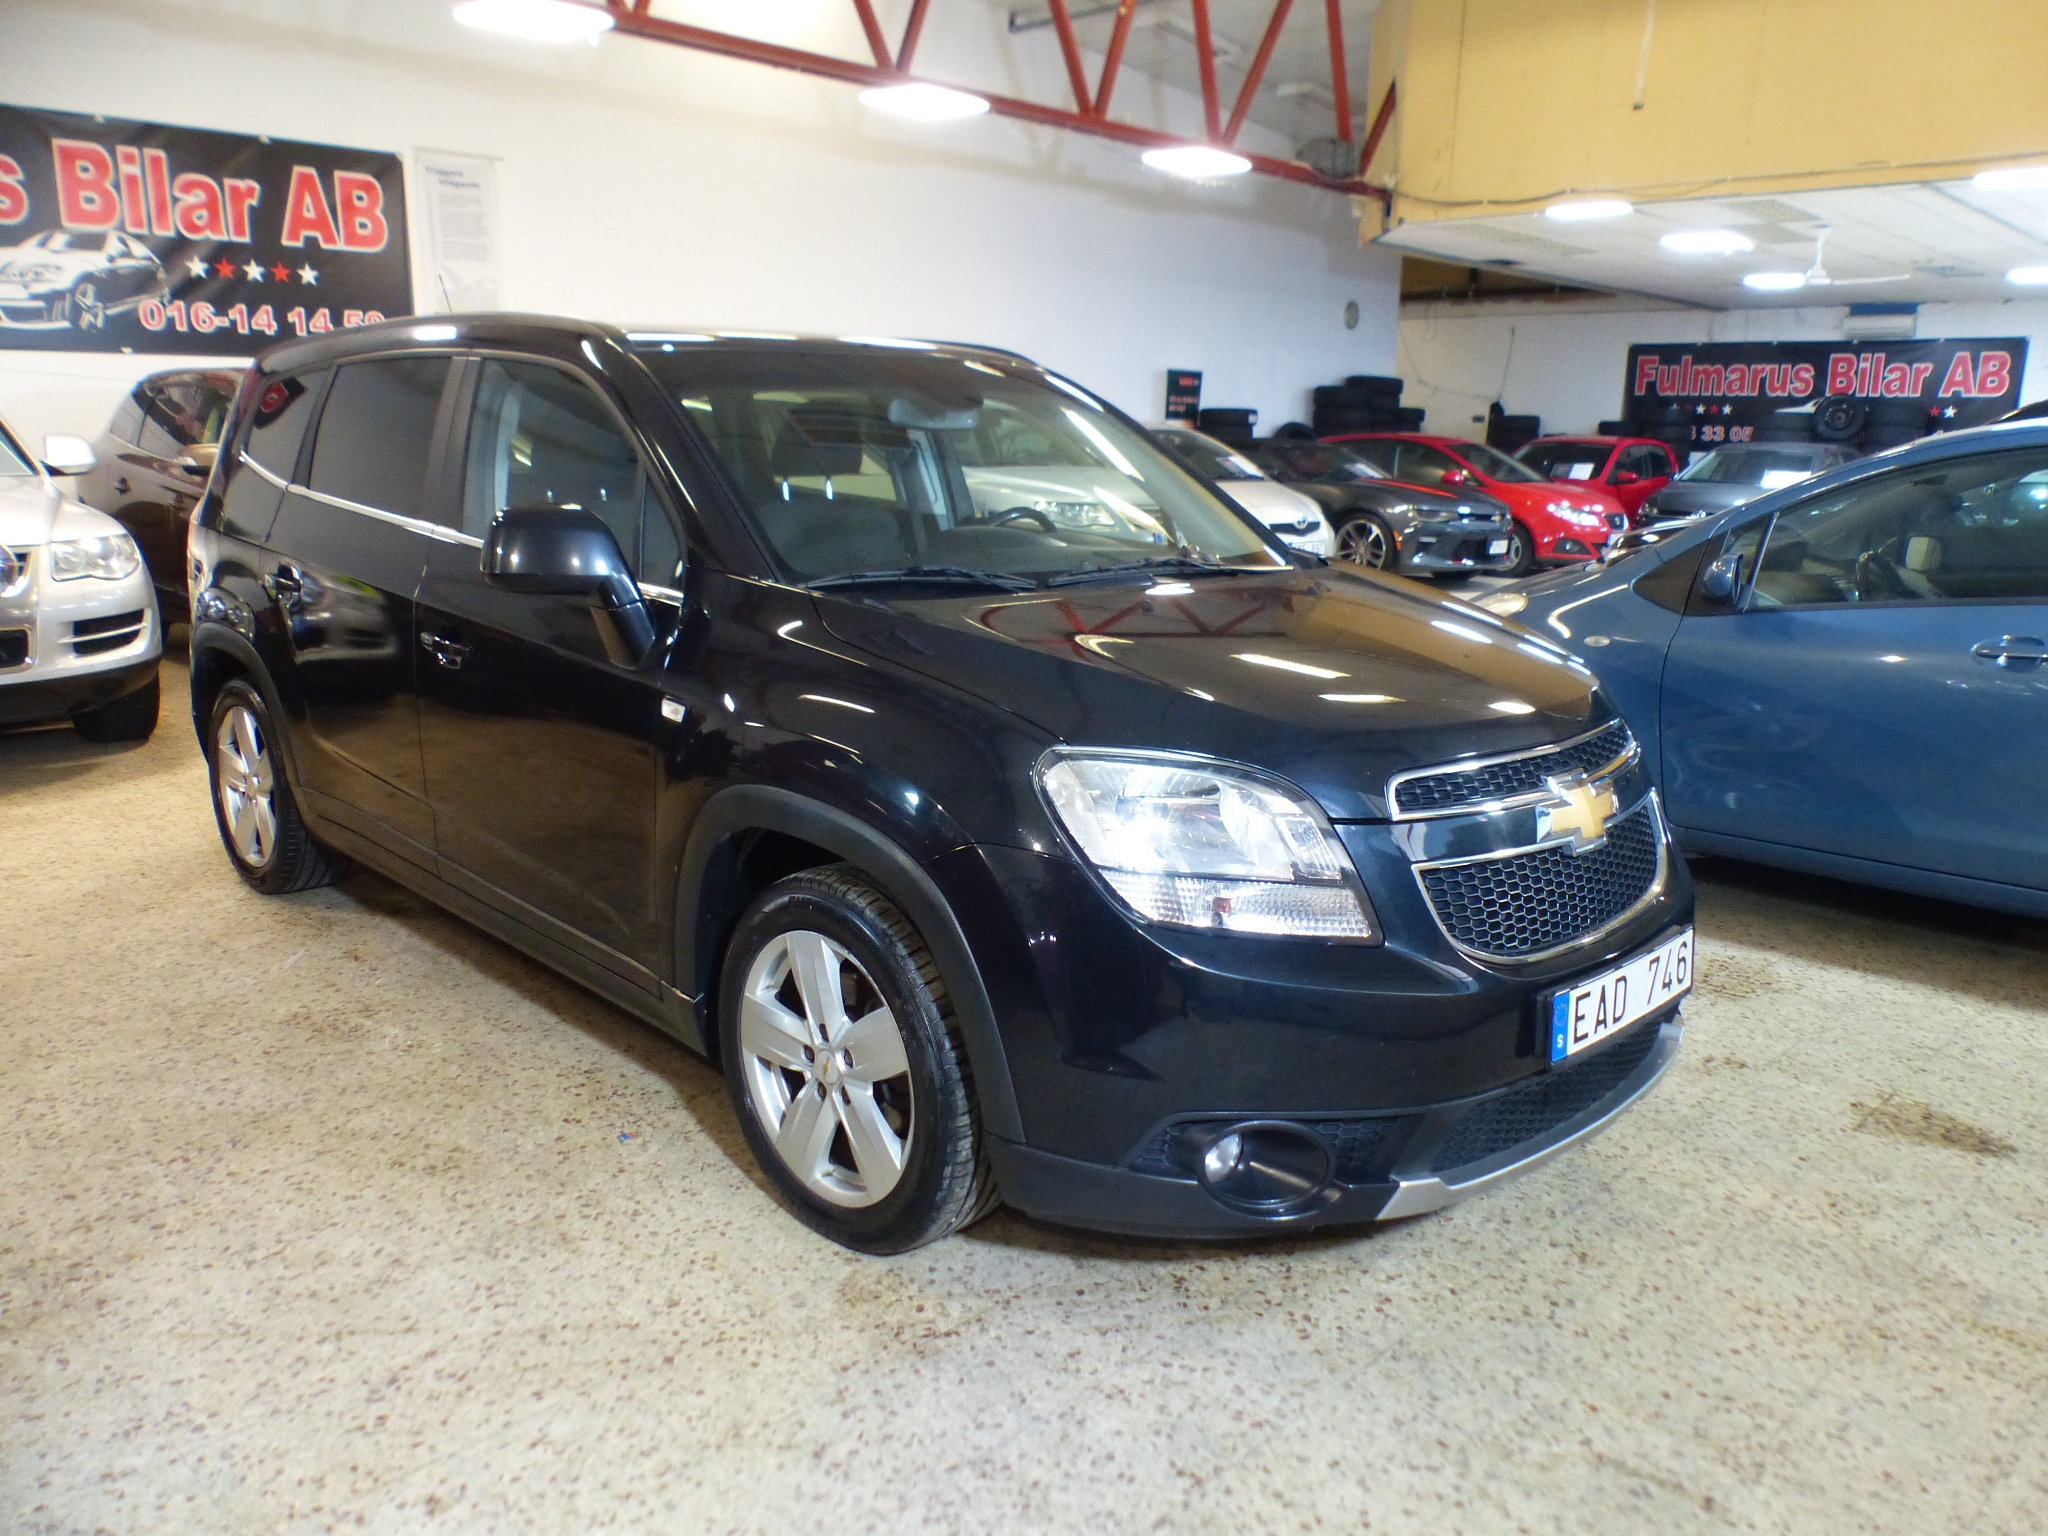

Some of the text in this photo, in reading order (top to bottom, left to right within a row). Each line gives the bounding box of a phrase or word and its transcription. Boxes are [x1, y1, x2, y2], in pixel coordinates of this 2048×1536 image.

[51, 137, 260, 243] Bilar
[281, 164, 389, 253] AB
[138, 299, 278, 336] 016-14
[288, 306, 334, 337] 14
[1634, 351, 2011, 398] Fulmarus Bilar AB
[1701, 425, 1726, 442] 33
[1573, 940, 1688, 1045] EAD 746
[1556, 1034, 1564, 1049] S
